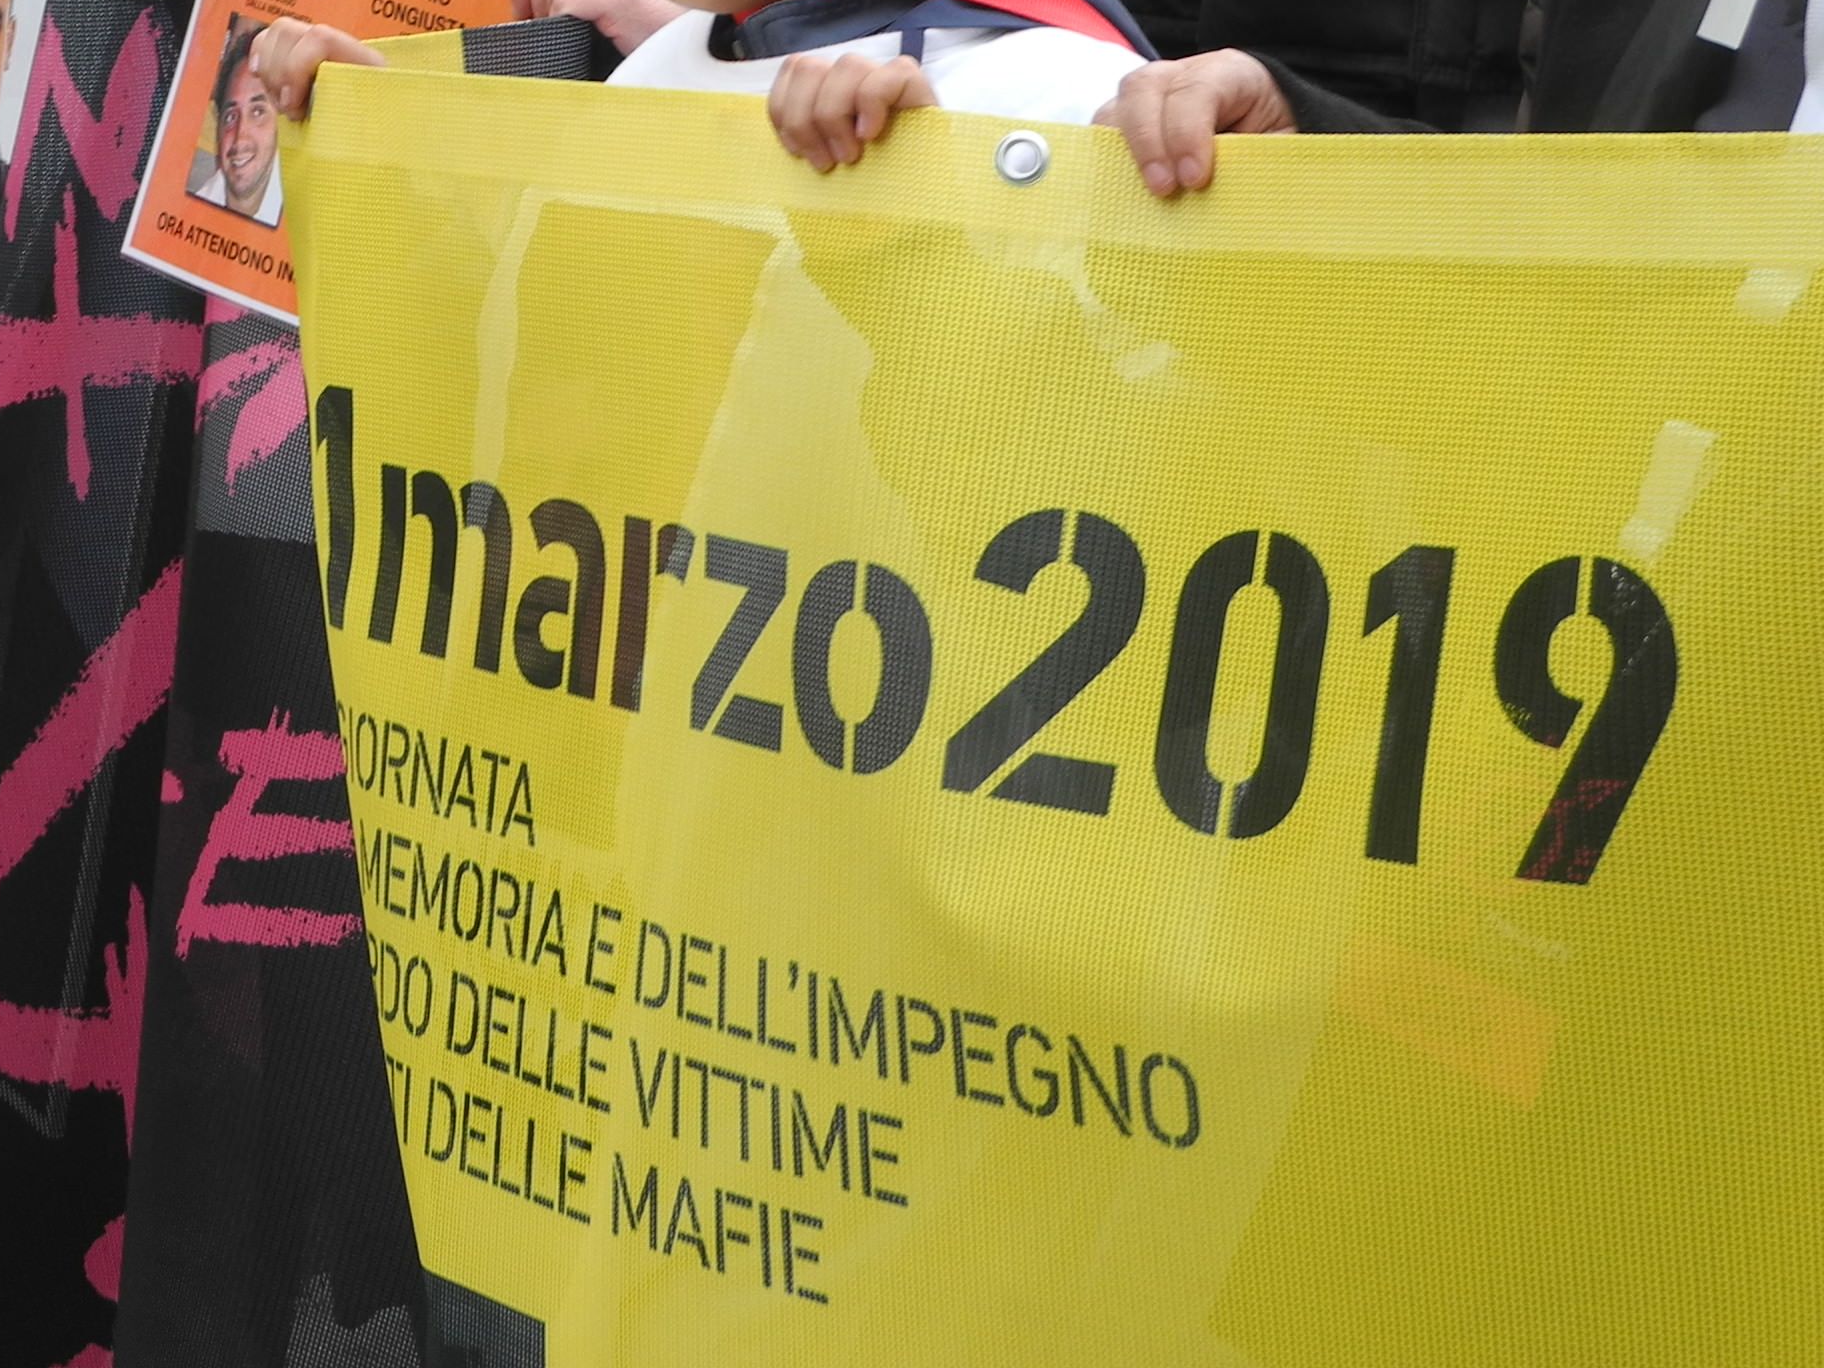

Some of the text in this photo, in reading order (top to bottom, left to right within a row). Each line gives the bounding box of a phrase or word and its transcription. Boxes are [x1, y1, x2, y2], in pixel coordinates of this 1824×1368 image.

[157, 212, 184, 239] ORA
[184, 224, 274, 275] ATTENDONO
[362, 829, 1202, 1149] MEMORIA E DELL'IMPEGNO
[447, 969, 613, 1114] DELLE
[630, 1037, 908, 1208] VITTIME
[424, 1080, 593, 1225] DELLE
[612, 1152, 830, 1304] MAFIE
